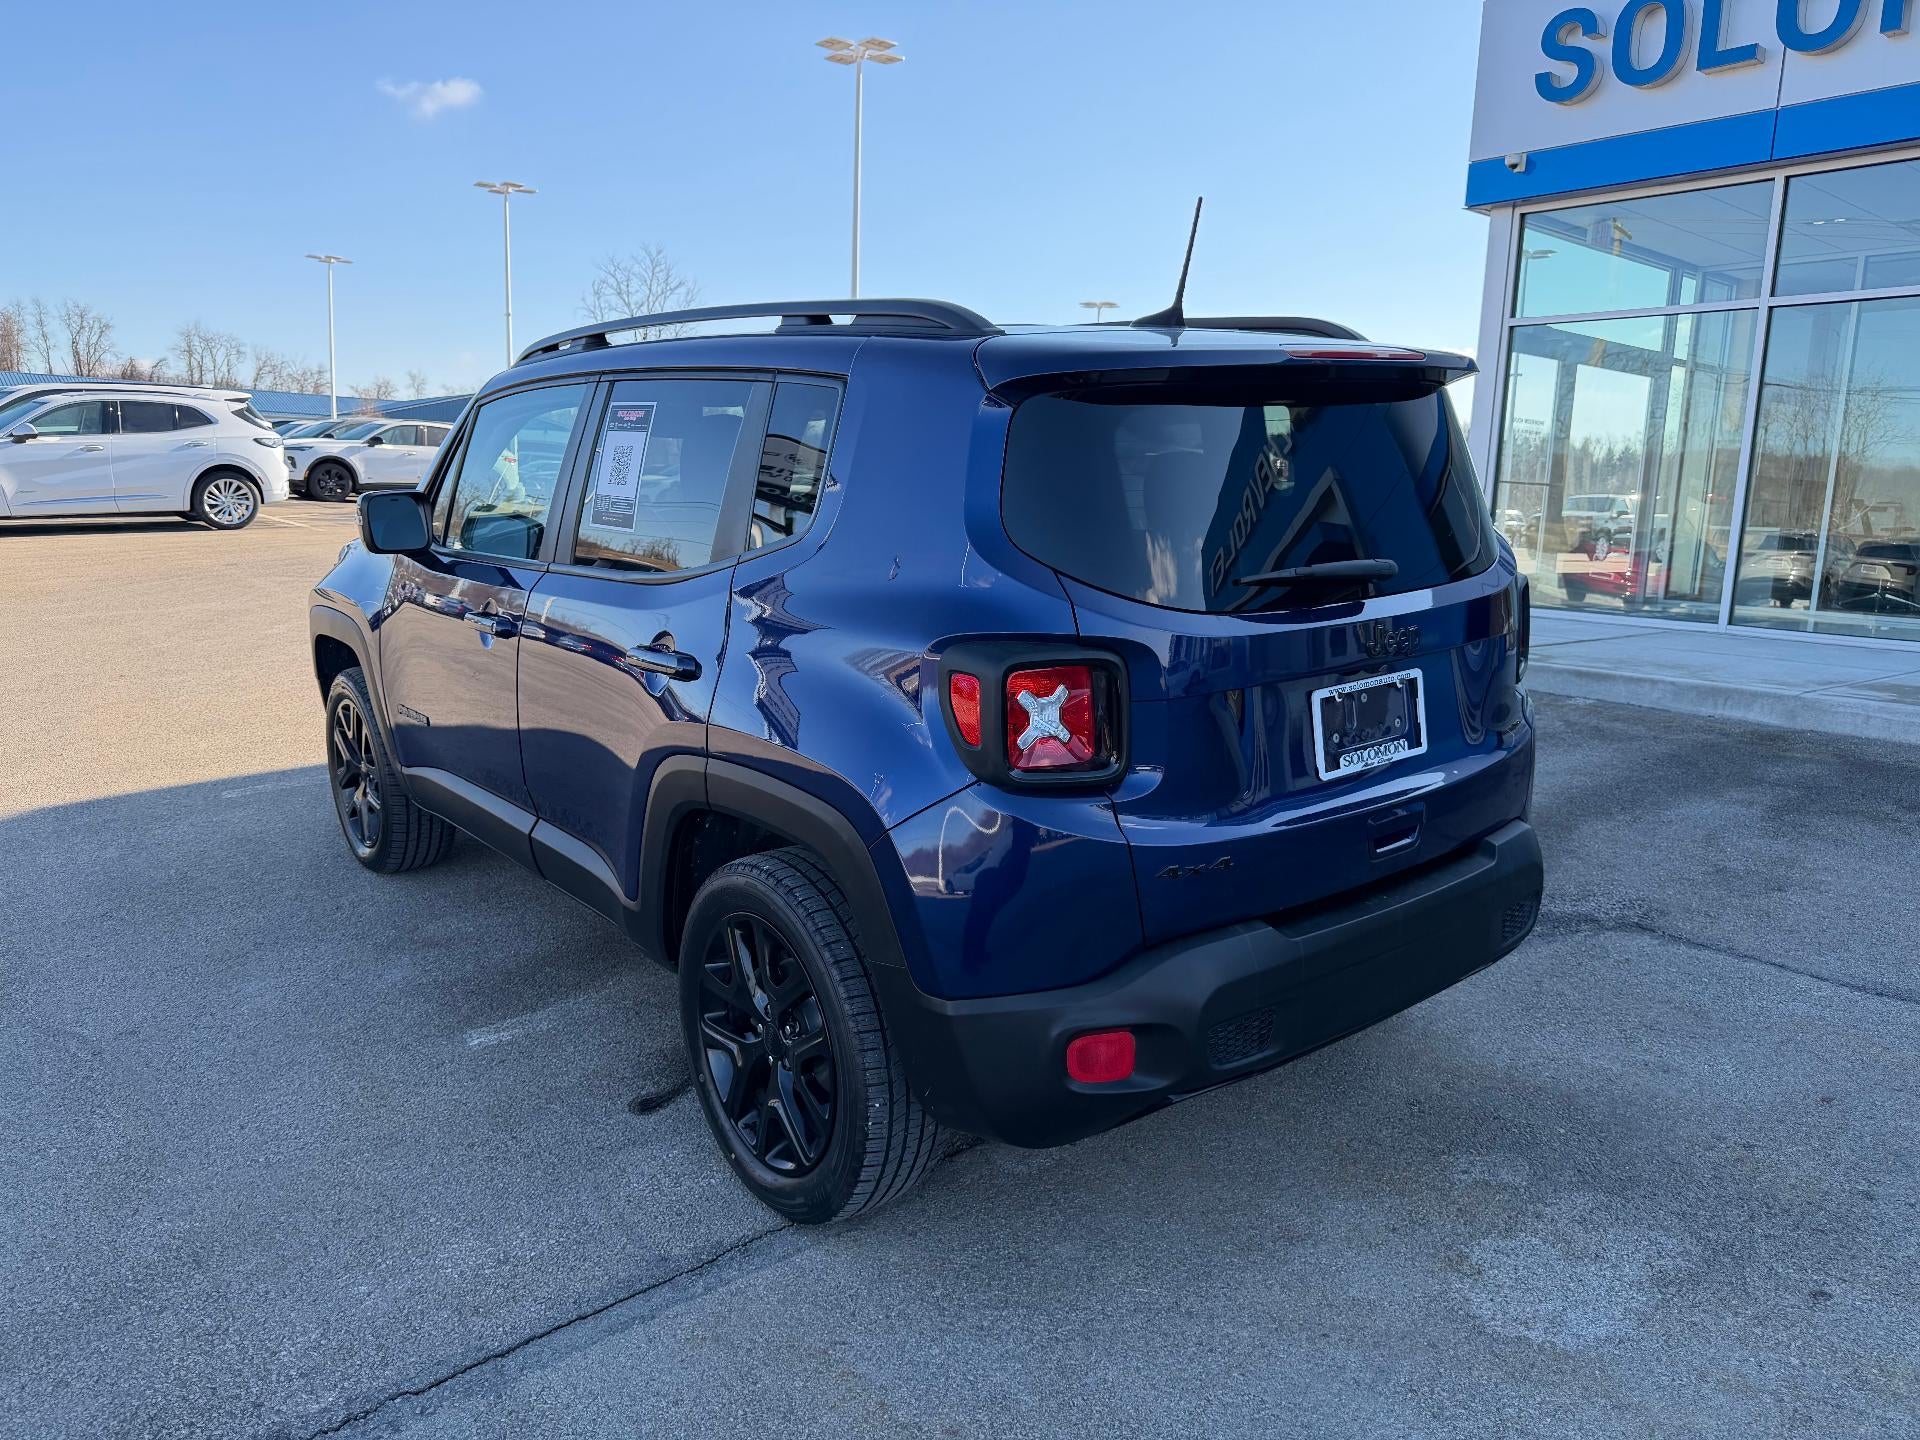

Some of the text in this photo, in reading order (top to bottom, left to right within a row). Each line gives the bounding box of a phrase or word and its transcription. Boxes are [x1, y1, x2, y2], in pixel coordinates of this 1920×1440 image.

[1535, 0, 1912, 104] SOLO
[1367, 624, 1420, 657] Jeep
[1343, 740, 1406, 767] SOLOMON
